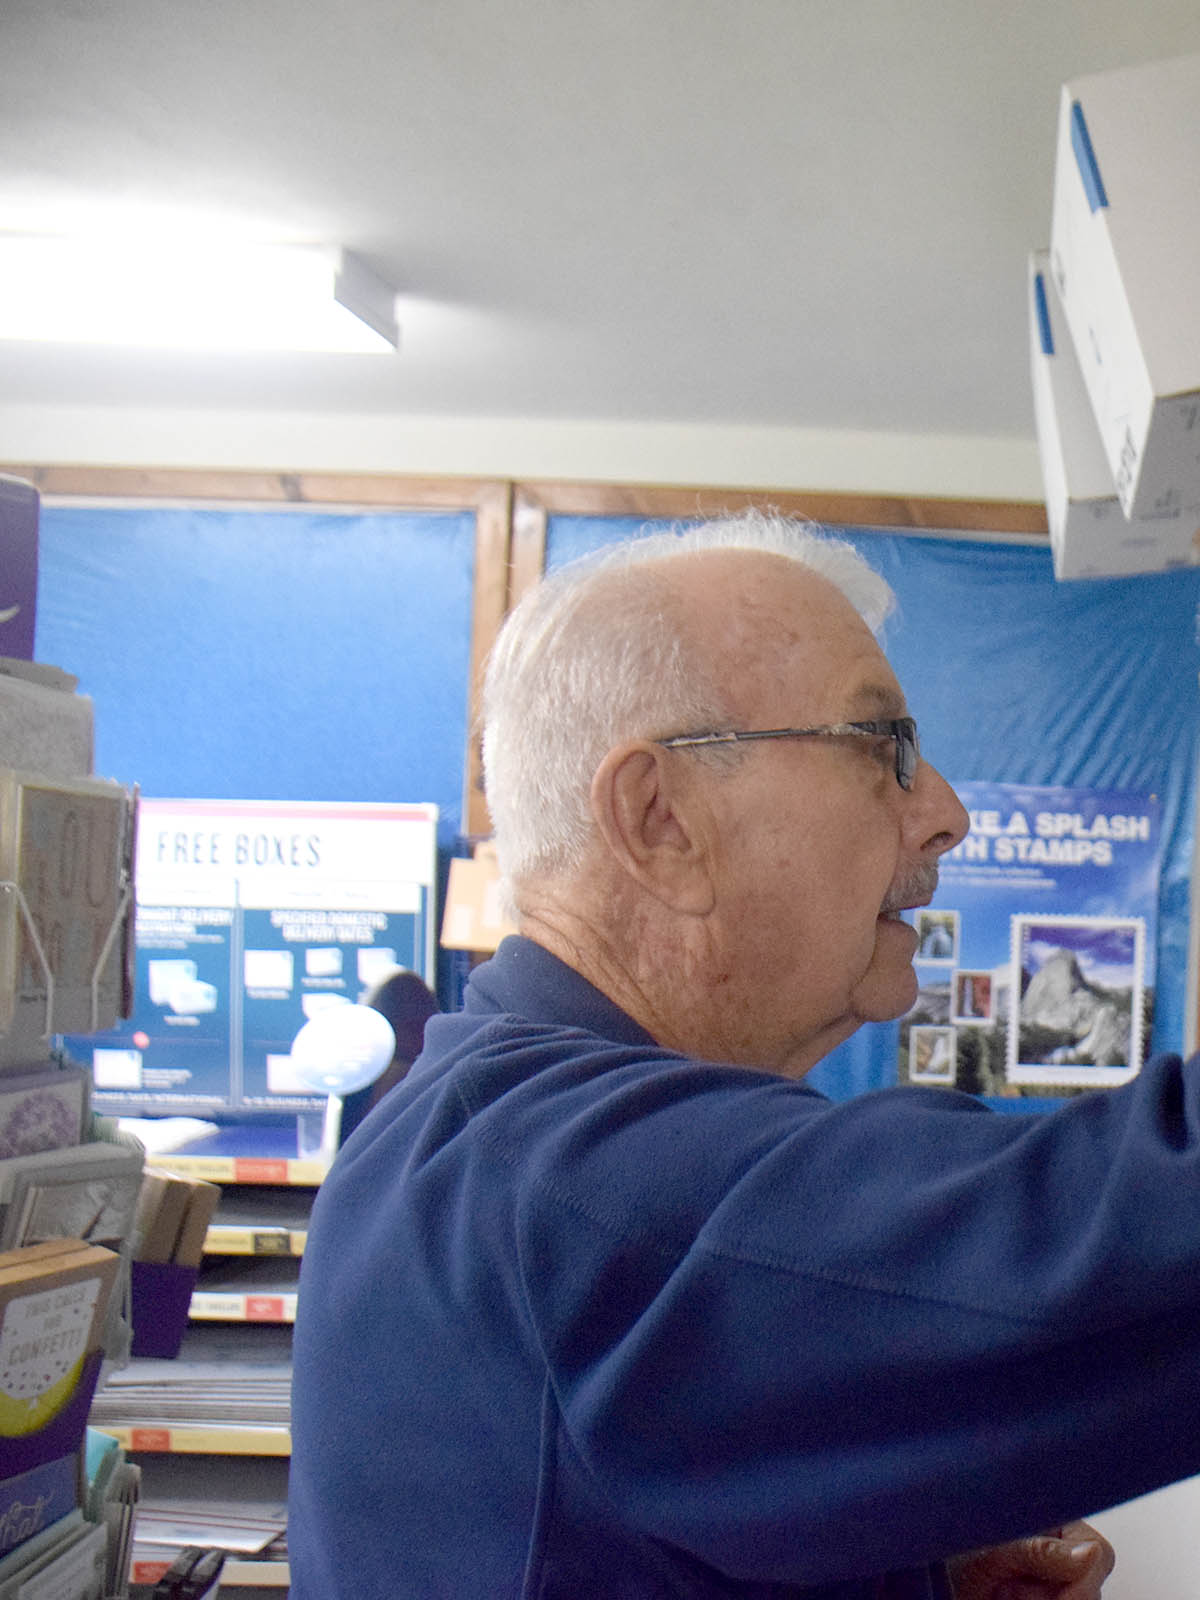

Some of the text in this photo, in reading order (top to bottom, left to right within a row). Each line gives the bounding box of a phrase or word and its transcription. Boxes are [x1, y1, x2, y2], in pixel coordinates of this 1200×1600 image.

[1006, 811, 1030, 836] A
[1035, 812, 1150, 842] SPLASH
[156, 831, 322, 868] FREE BOXES
[994, 836, 1114, 868] STAMPS
